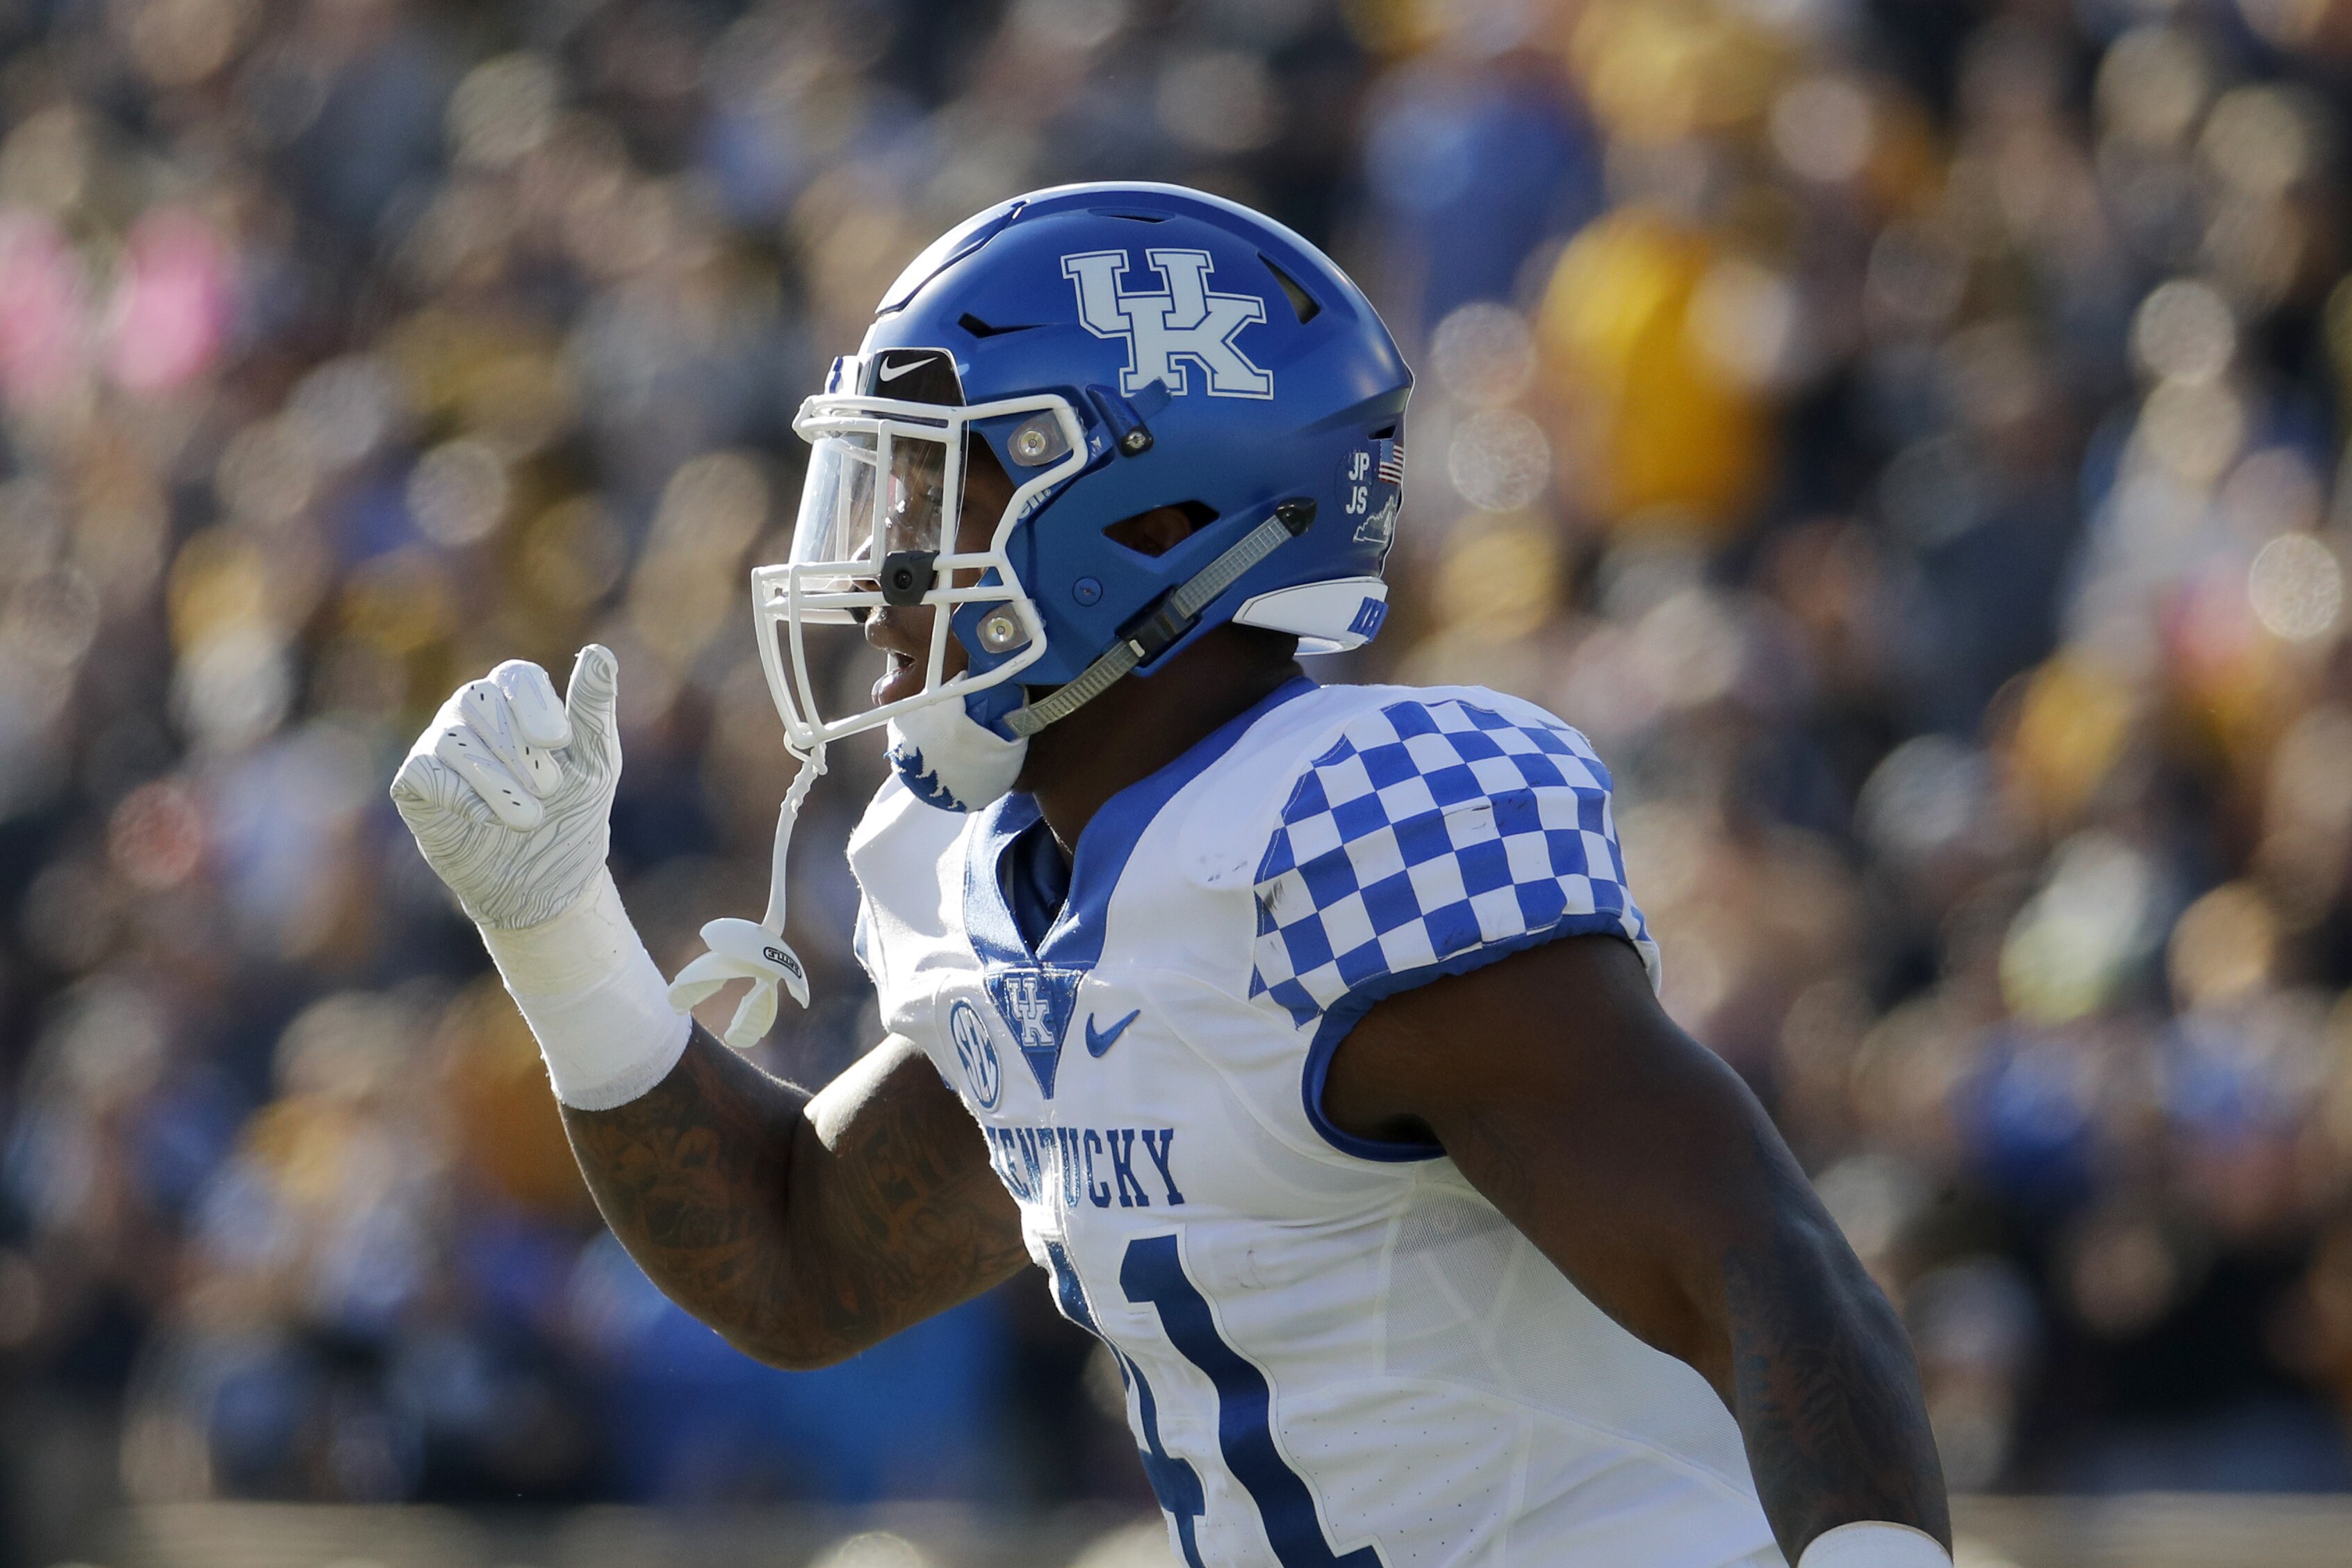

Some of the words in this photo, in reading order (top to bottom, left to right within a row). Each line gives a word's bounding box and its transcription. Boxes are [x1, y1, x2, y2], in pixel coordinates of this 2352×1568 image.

[1060, 247, 1275, 400] UK
[1348, 452, 1370, 481] JP
[1346, 486, 1368, 514] JS
[1006, 977, 1054, 1047] UK
